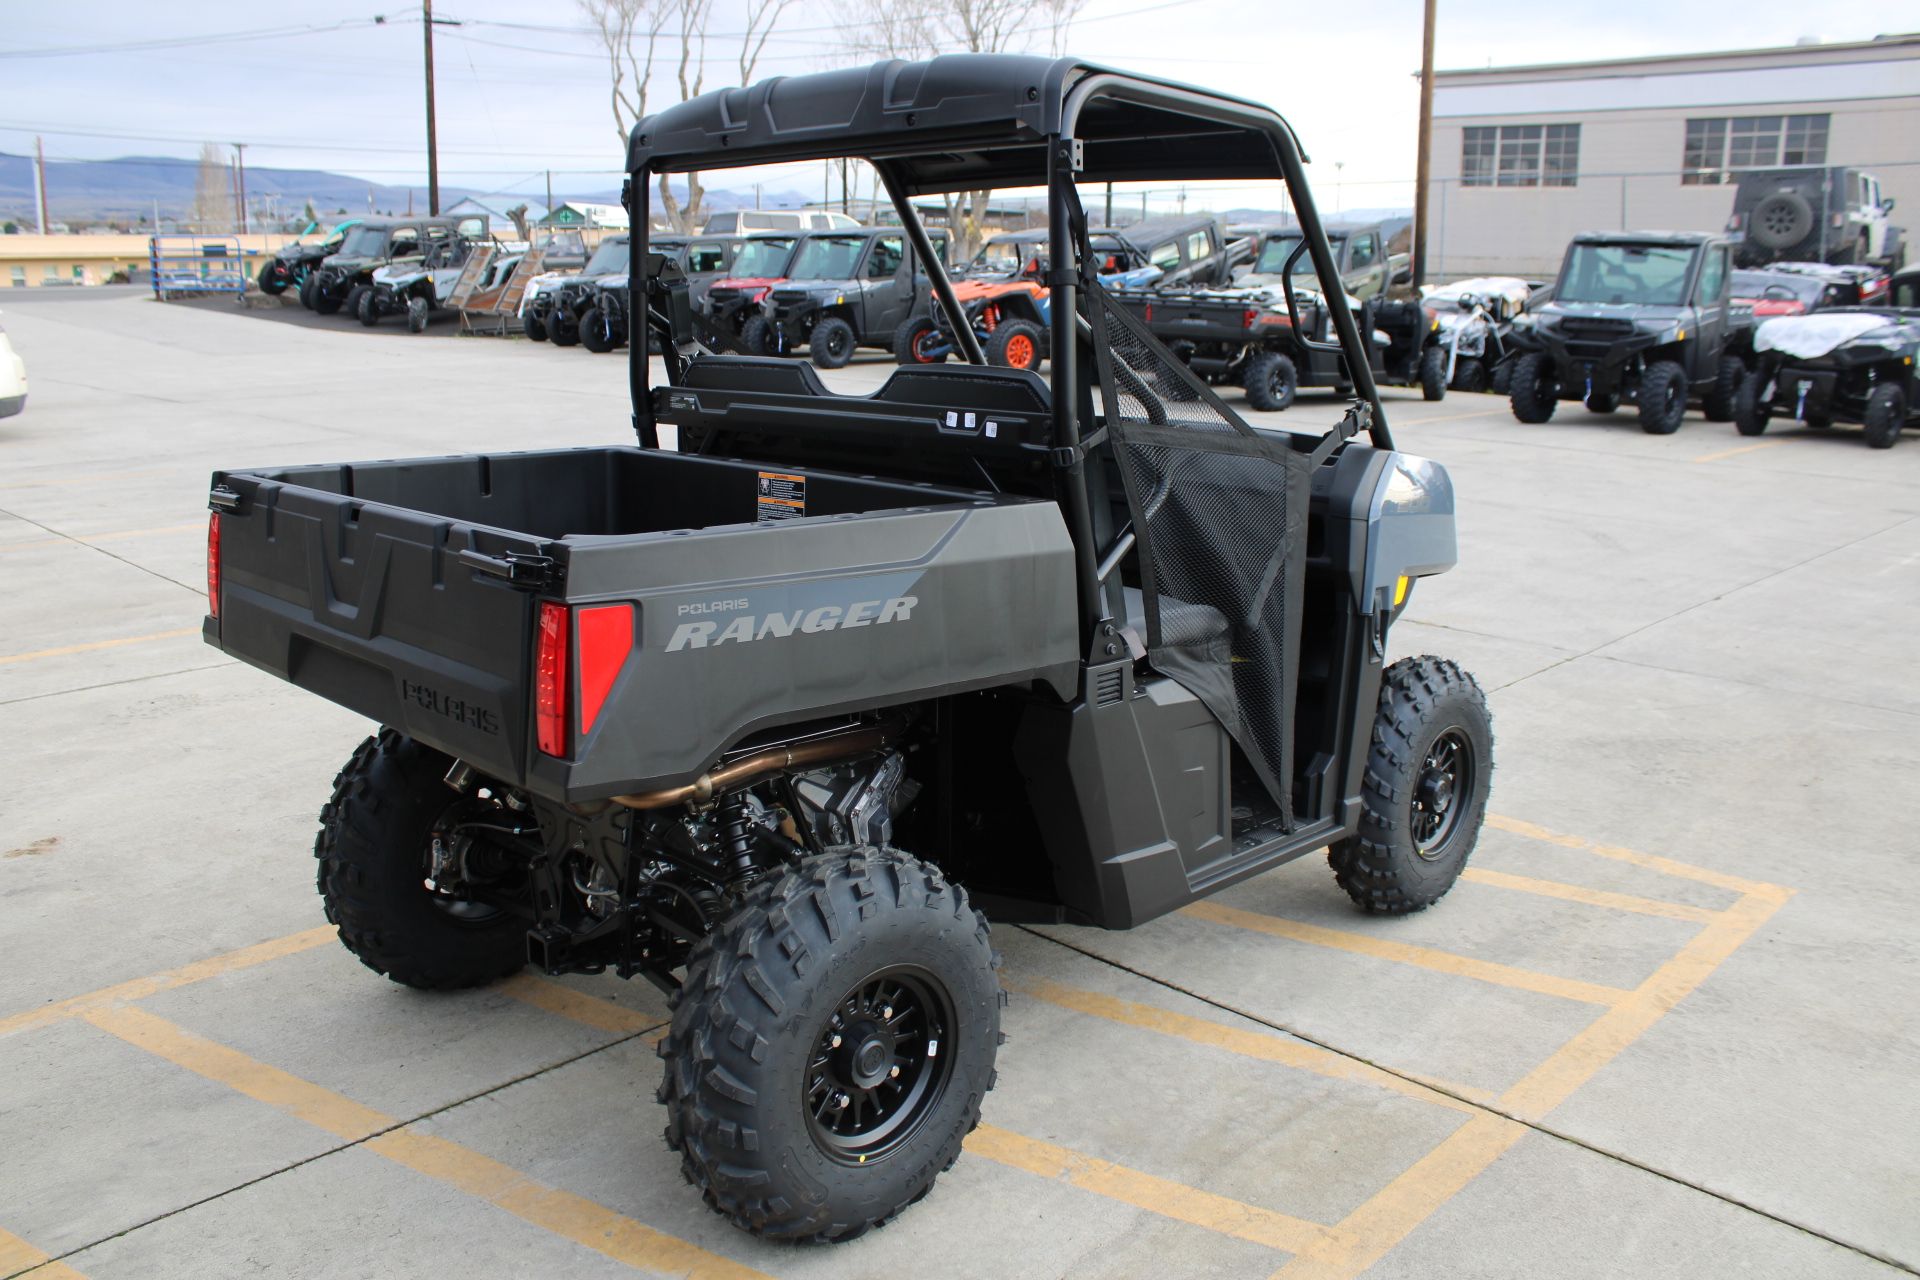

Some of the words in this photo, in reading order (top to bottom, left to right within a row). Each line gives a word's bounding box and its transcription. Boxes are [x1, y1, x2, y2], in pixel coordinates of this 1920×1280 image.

[664, 596, 918, 653] RANGER
[677, 598, 749, 616] POLARIS
[402, 679, 498, 736] POLARIS
